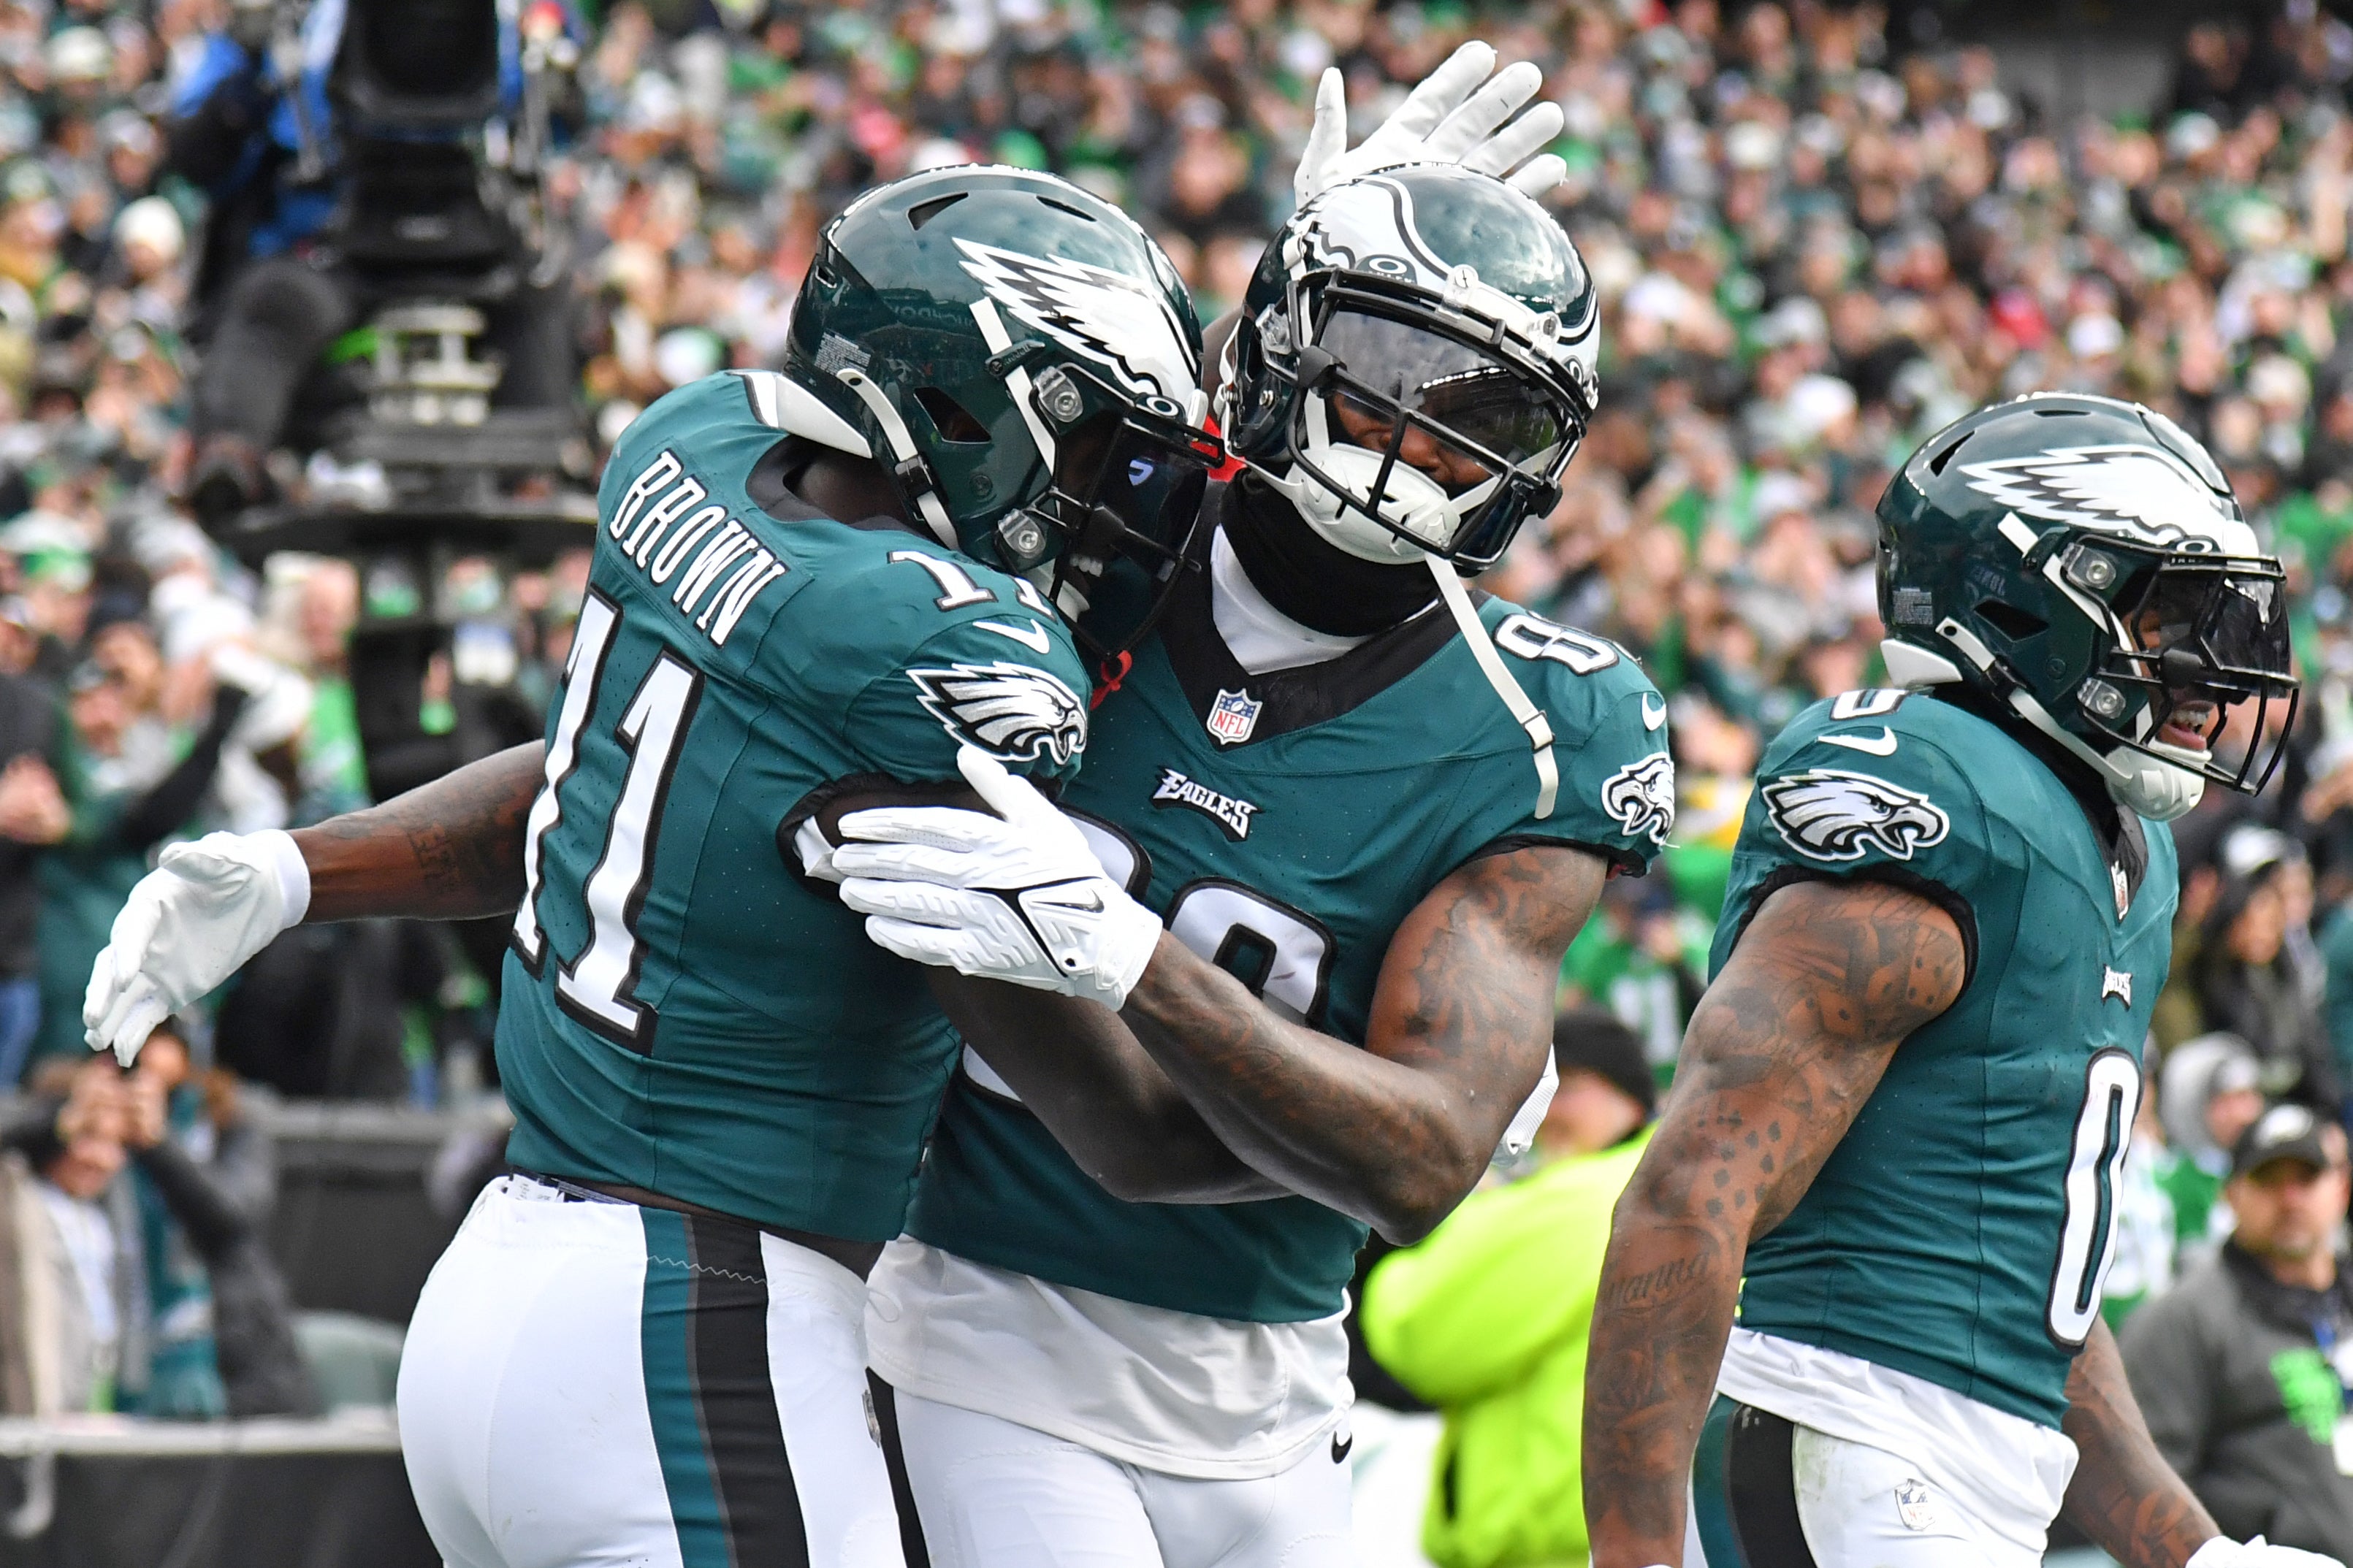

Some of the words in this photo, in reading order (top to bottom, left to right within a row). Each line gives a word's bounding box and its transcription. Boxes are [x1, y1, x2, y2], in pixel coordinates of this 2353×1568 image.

[609, 448, 790, 649] BROWN
[886, 550, 1058, 624] 11
[1213, 711, 1246, 735] NFL
[512, 584, 706, 1057] 11
[1151, 768, 1259, 839] EAGLES
[2046, 1047, 2143, 1353] 0
